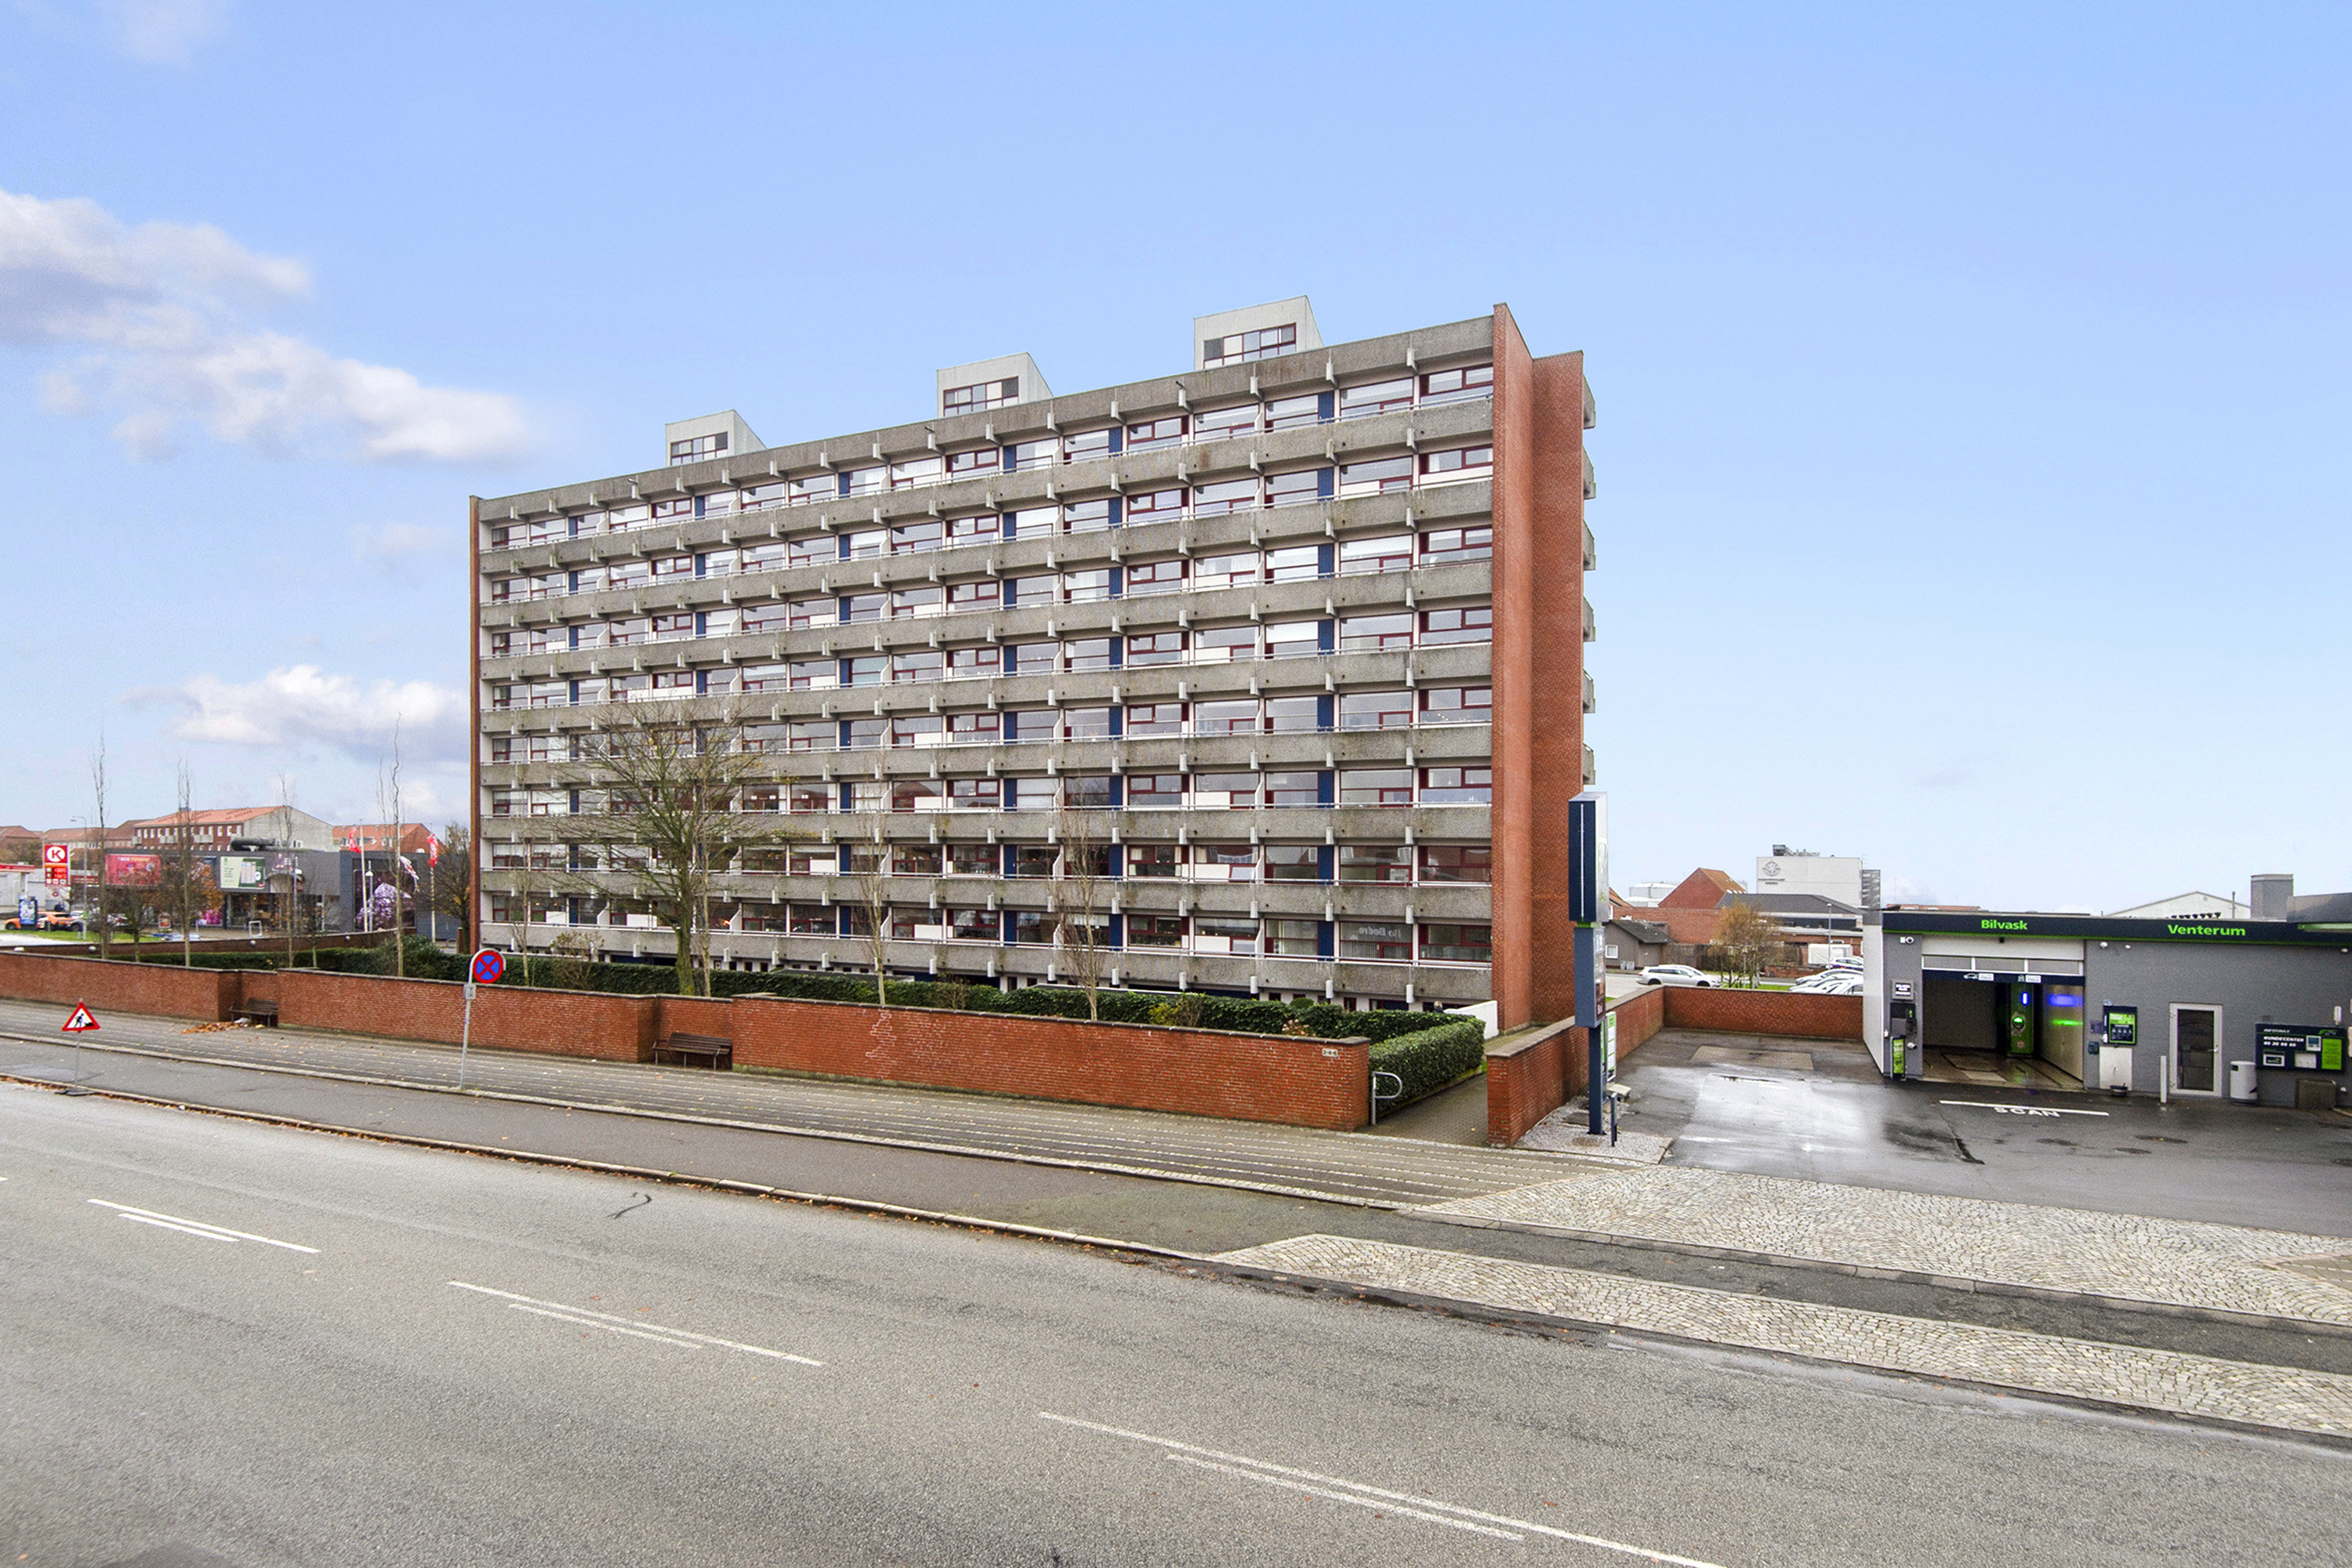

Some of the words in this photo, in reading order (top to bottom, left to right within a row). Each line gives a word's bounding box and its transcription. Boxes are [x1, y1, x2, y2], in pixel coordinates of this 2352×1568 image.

[52, 850, 63, 860] K
[1980, 919, 2028, 931] Bilvask
[2167, 924, 2246, 937] Venterum
[1994, 1107, 2060, 1117] SCAN
